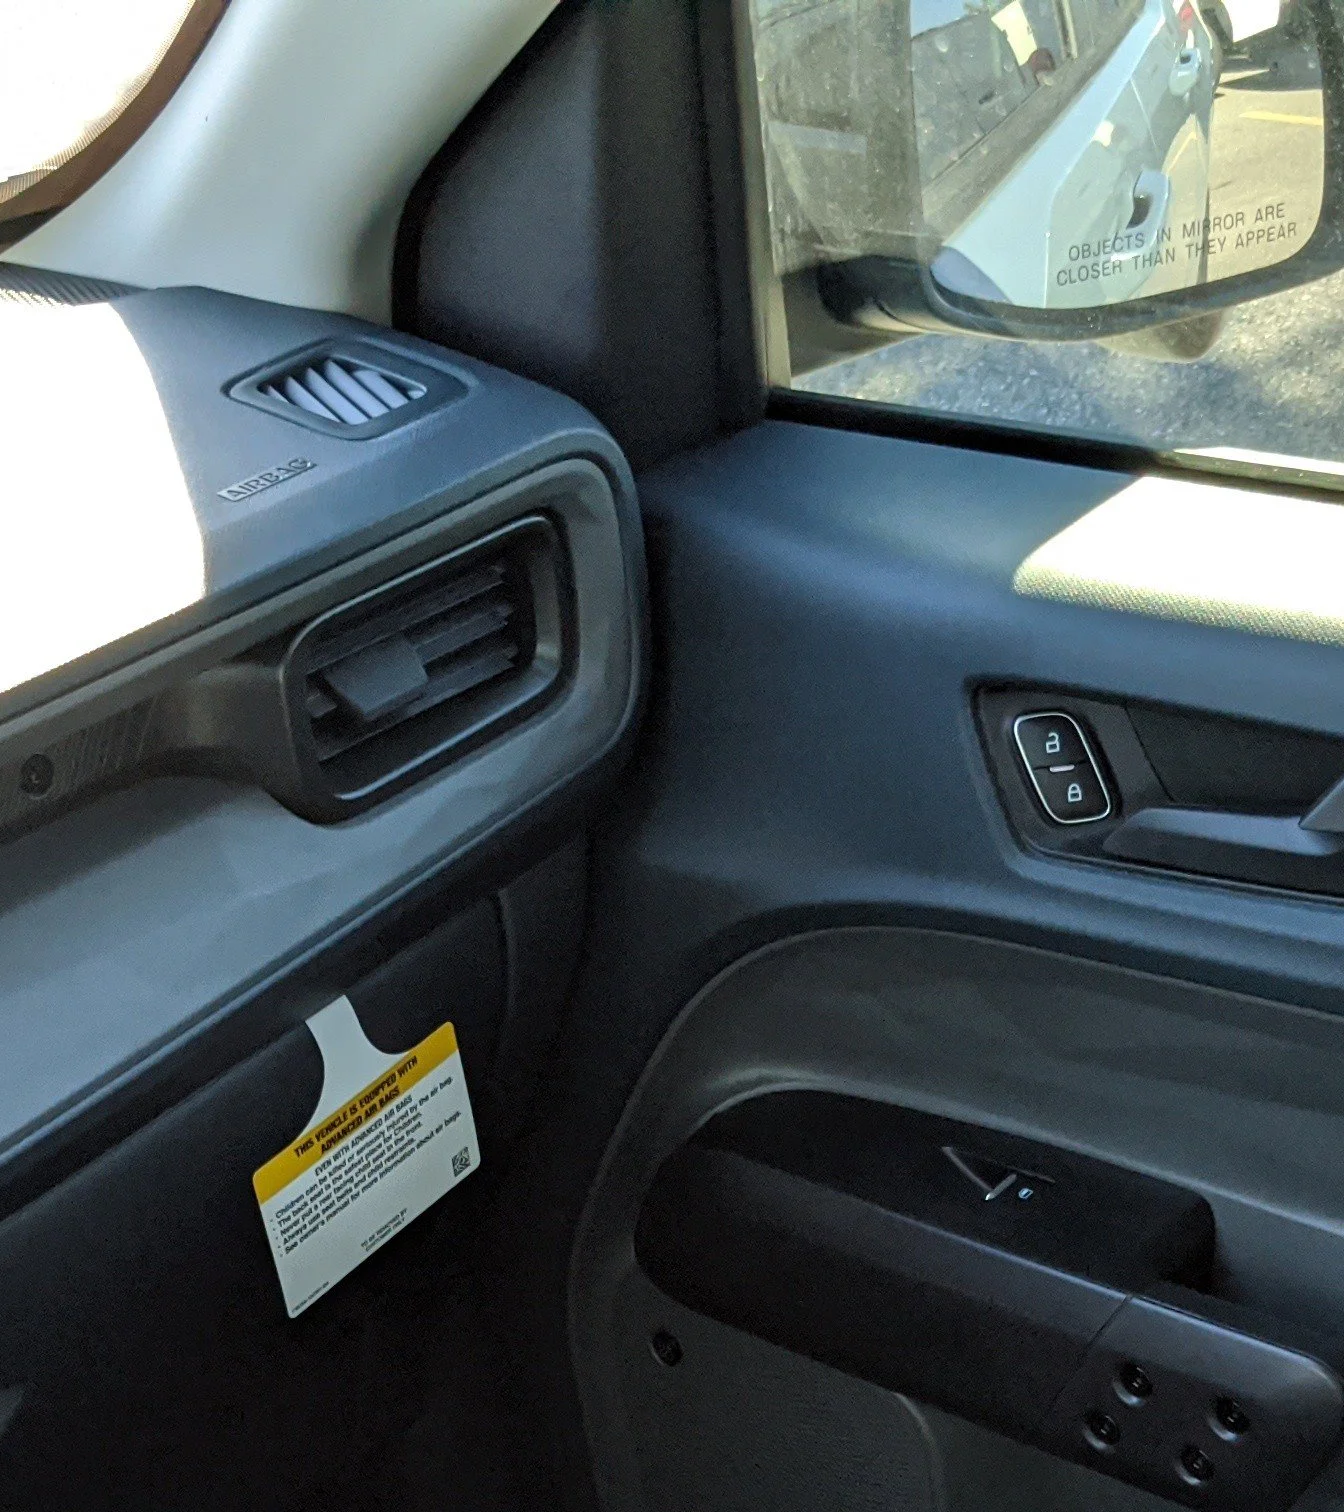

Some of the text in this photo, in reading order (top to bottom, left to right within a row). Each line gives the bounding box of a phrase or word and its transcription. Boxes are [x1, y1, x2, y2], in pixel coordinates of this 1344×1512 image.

[1056, 222, 1297, 287] CLOSER THAN THEY APPEAR
[1068, 202, 1286, 262] OBJECTS IN MIRROR ARE
[226, 458, 309, 499] AIRBAG
[294, 1055, 418, 1158] THIS VEHICLE IS EQUIPPED WITH
[314, 1094, 413, 1177] EVEN WITH ADVANCED AIR BAGS
[320, 1085, 400, 1155] ADVANCED AIR BAGS
[275, 1194, 305, 1219] Children
[305, 1183, 318, 1196] can
[318, 1176, 328, 1185] be
[328, 1160, 347, 1178] killed
[347, 1154, 355, 1163] or
[386, 1109, 409, 1132] injured
[409, 1104, 418, 1114] by
[419, 1094, 429, 1106] the
[430, 1086, 439, 1097] air
[277, 1215, 291, 1228] The
[291, 1201, 309, 1217] back
[309, 1188, 324, 1203] seat
[332, 1174, 343, 1185] the
[344, 1156, 364, 1176] safest
[365, 1142, 383, 1161] place
[383, 1134, 393, 1145] for
[280, 1219, 300, 1237] Never
[301, 1207, 313, 1222] put
[319, 1192, 332, 1206] rear
[333, 1176, 354, 1195] facing
[355, 1160, 371, 1178] child
[372, 1149, 386, 1164] seat
[394, 1135, 405, 1146] the
[285, 1241, 299, 1255] See
[326, 1199, 350, 1222] manual
[350, 1191, 360, 1202] for
[361, 1177, 378, 1193] more
[379, 1147, 416, 1180] information
[416, 1131, 435, 1150] about
[435, 1124, 444, 1134] air
[283, 1223, 307, 1246] Always
[308, 1213, 321, 1226] use
[321, 1200, 336, 1215] seat
[336, 1187, 353, 1203] belts
[354, 1175, 367, 1189] and
[367, 1161, 384, 1179] child
